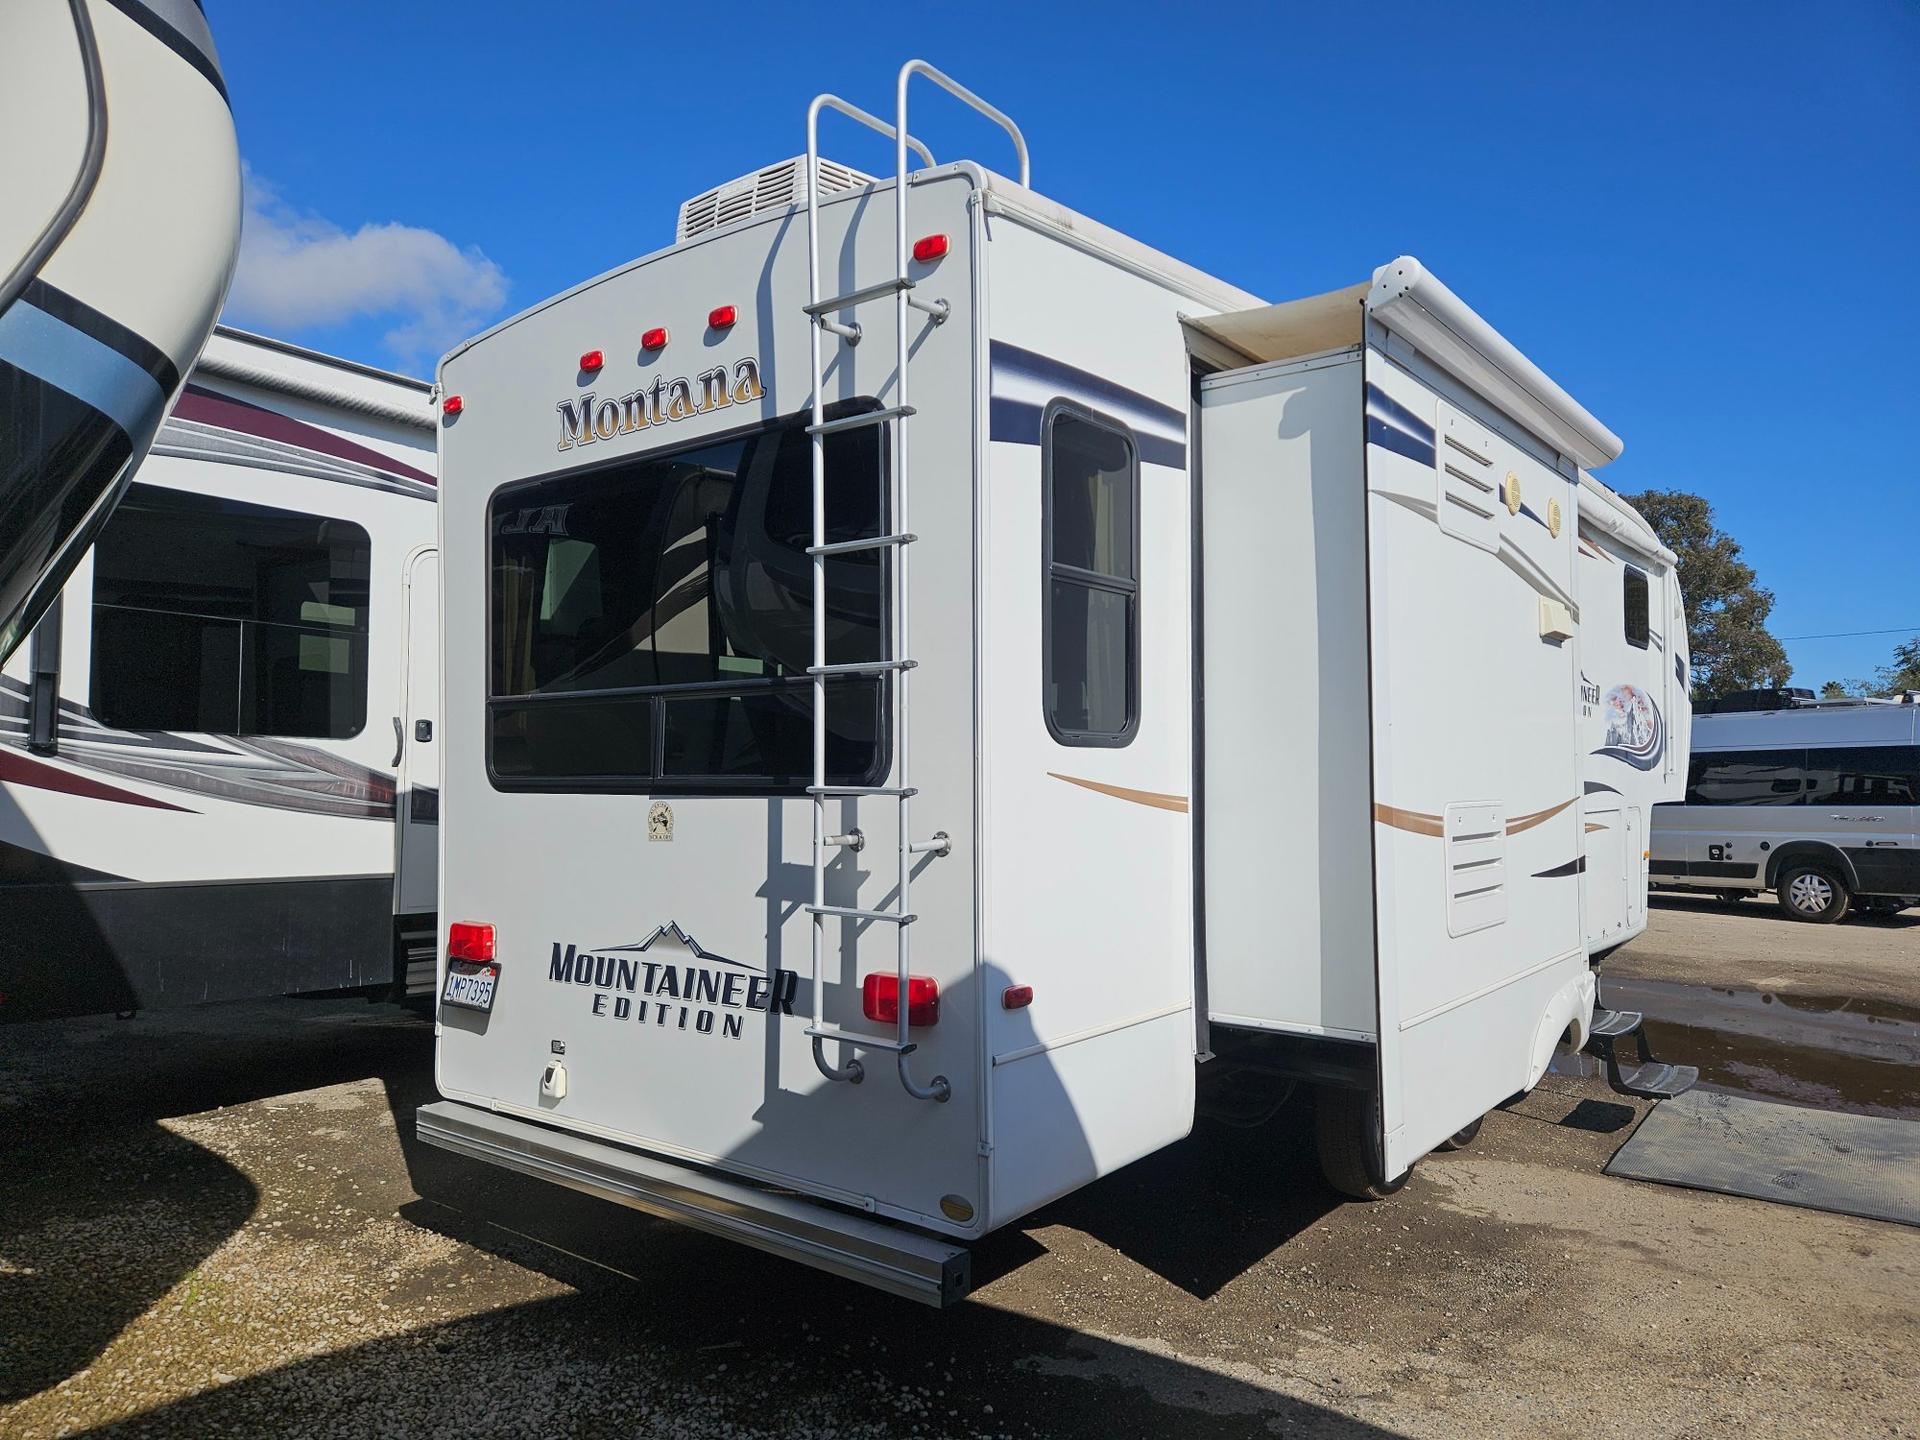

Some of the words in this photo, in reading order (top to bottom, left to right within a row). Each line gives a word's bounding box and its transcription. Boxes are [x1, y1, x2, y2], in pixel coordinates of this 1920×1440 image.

[557, 357, 767, 452] Montana
[446, 975, 492, 1004] 1MP7395
[548, 942, 799, 1016] MOUNTAINEER
[591, 993, 745, 1040] EDITION
